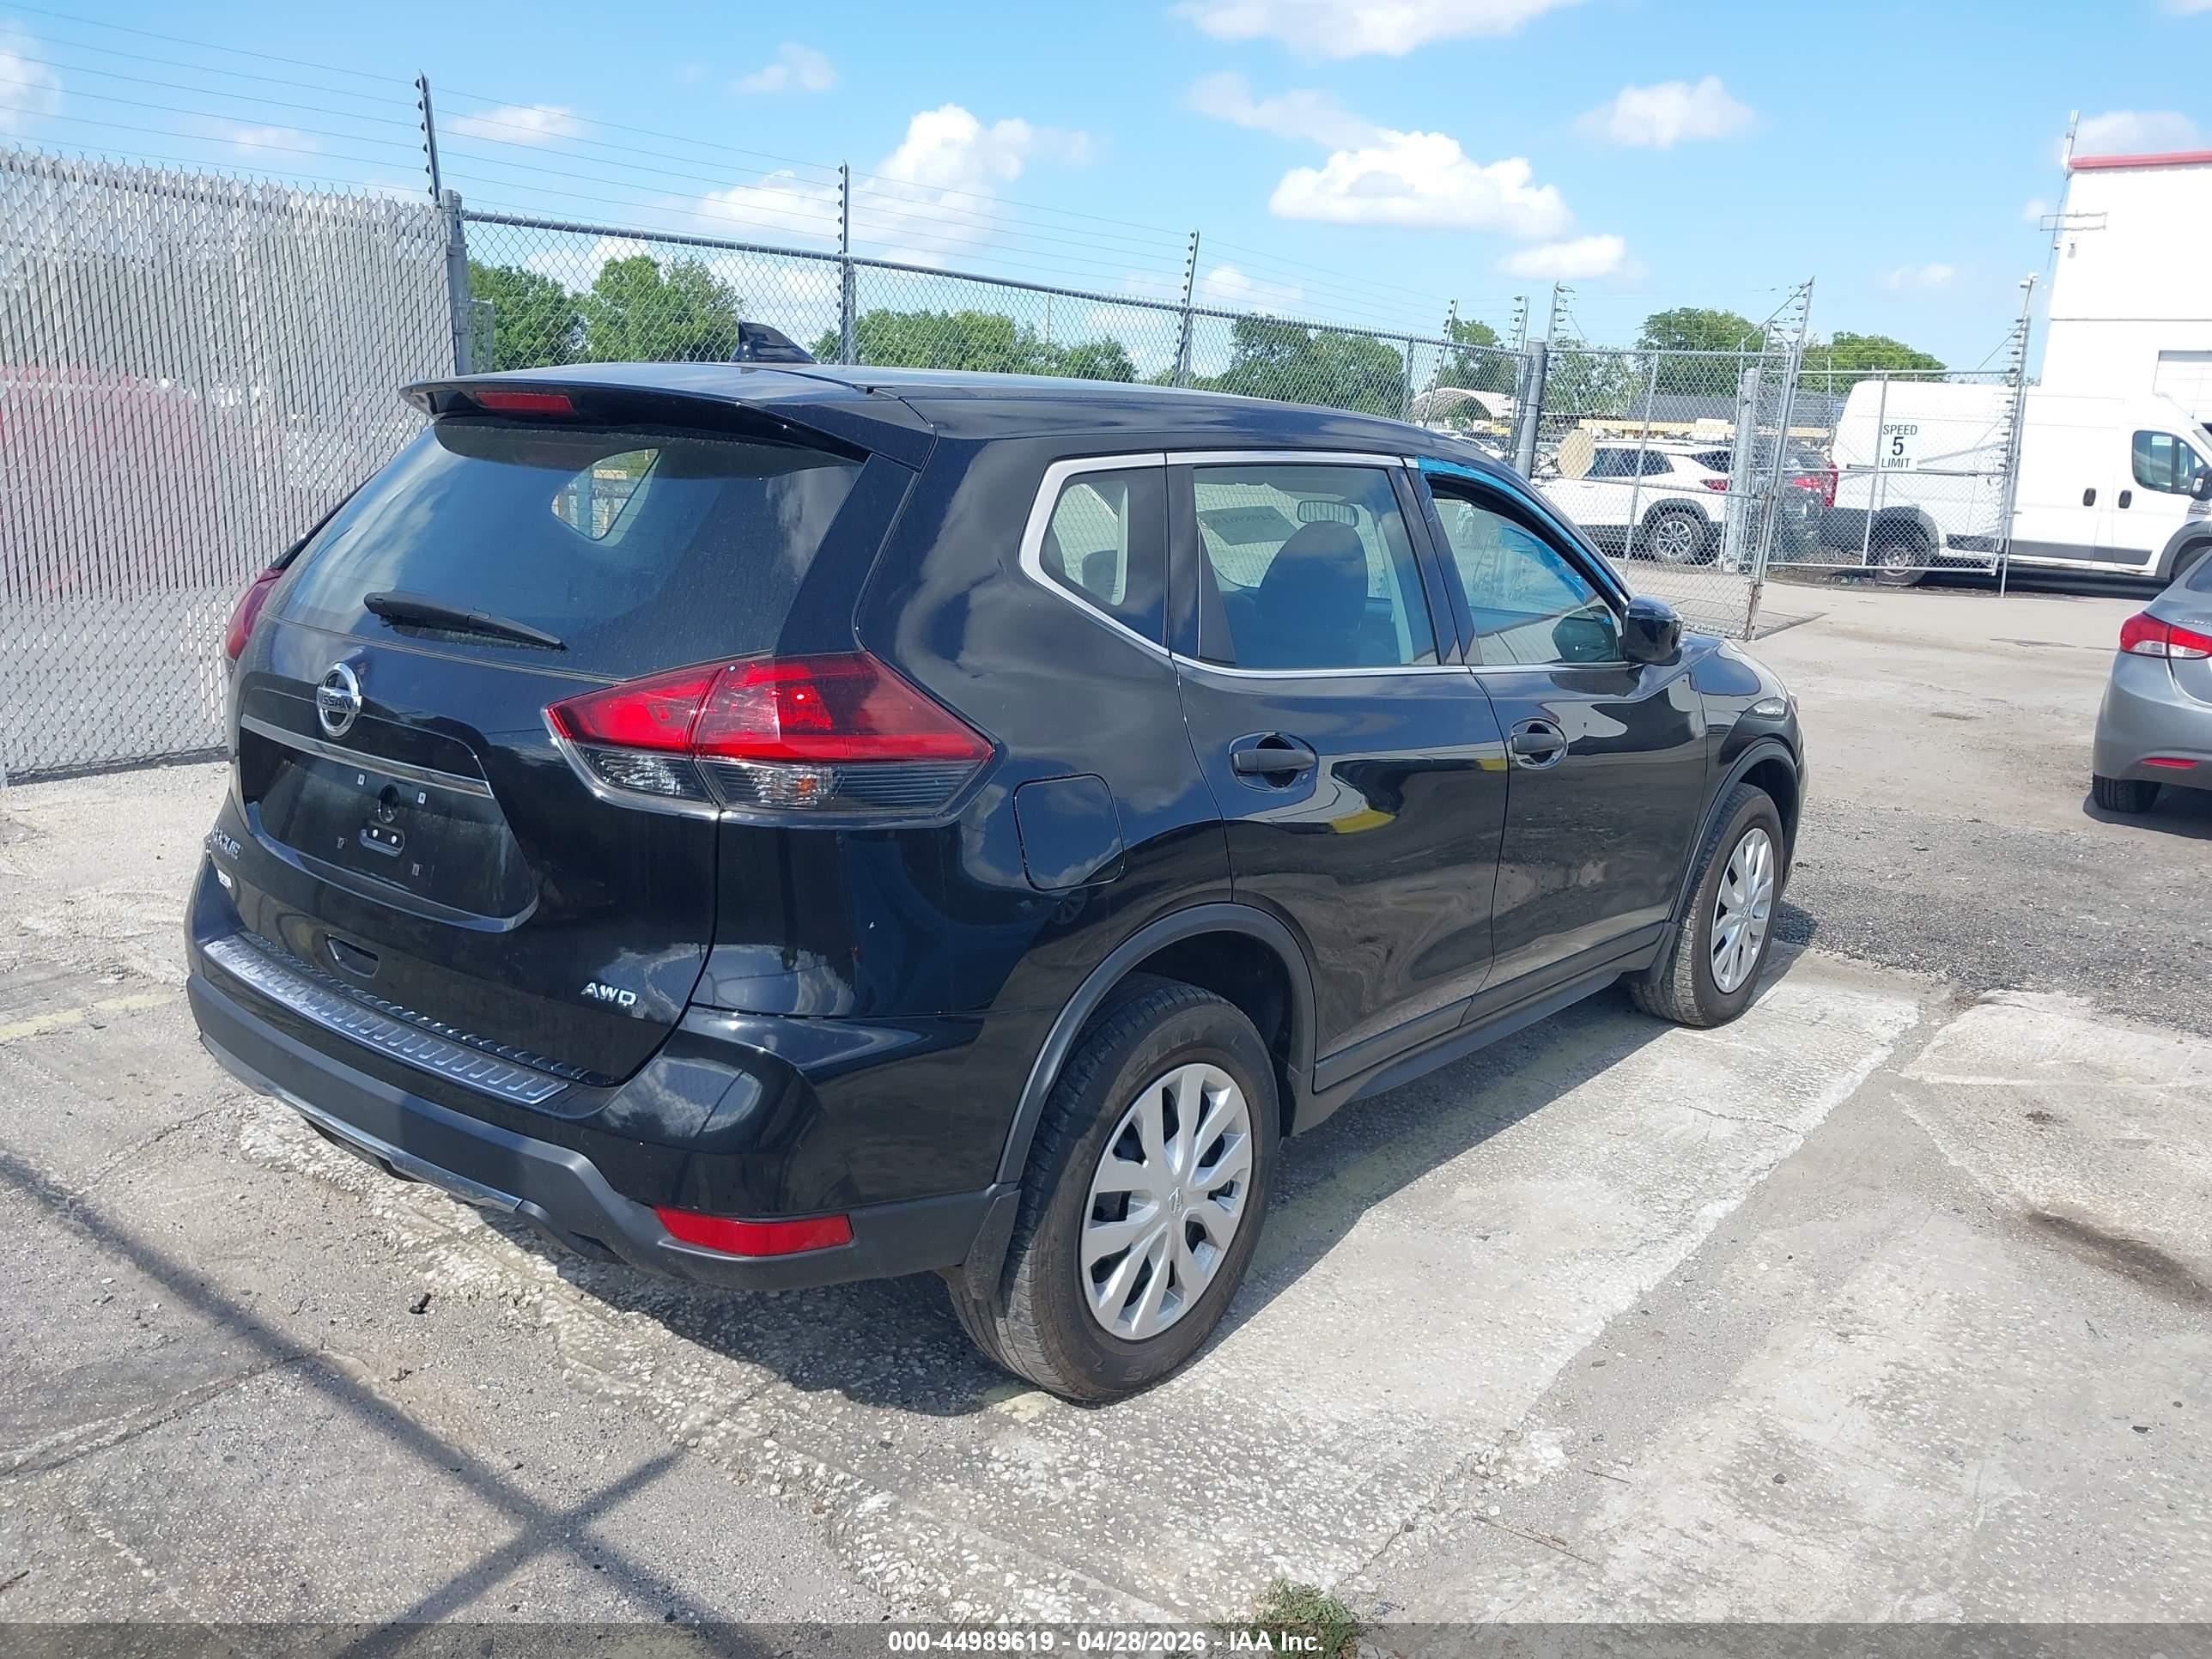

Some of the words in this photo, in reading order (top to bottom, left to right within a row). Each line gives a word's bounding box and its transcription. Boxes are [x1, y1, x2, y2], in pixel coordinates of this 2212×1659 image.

[1883, 424, 1917, 434] SPEED
[1892, 436, 1905, 456] 5
[1881, 458, 1911, 468] LIMIT
[317, 692, 352, 710] NISSAN
[580, 981, 637, 1006] AWD
